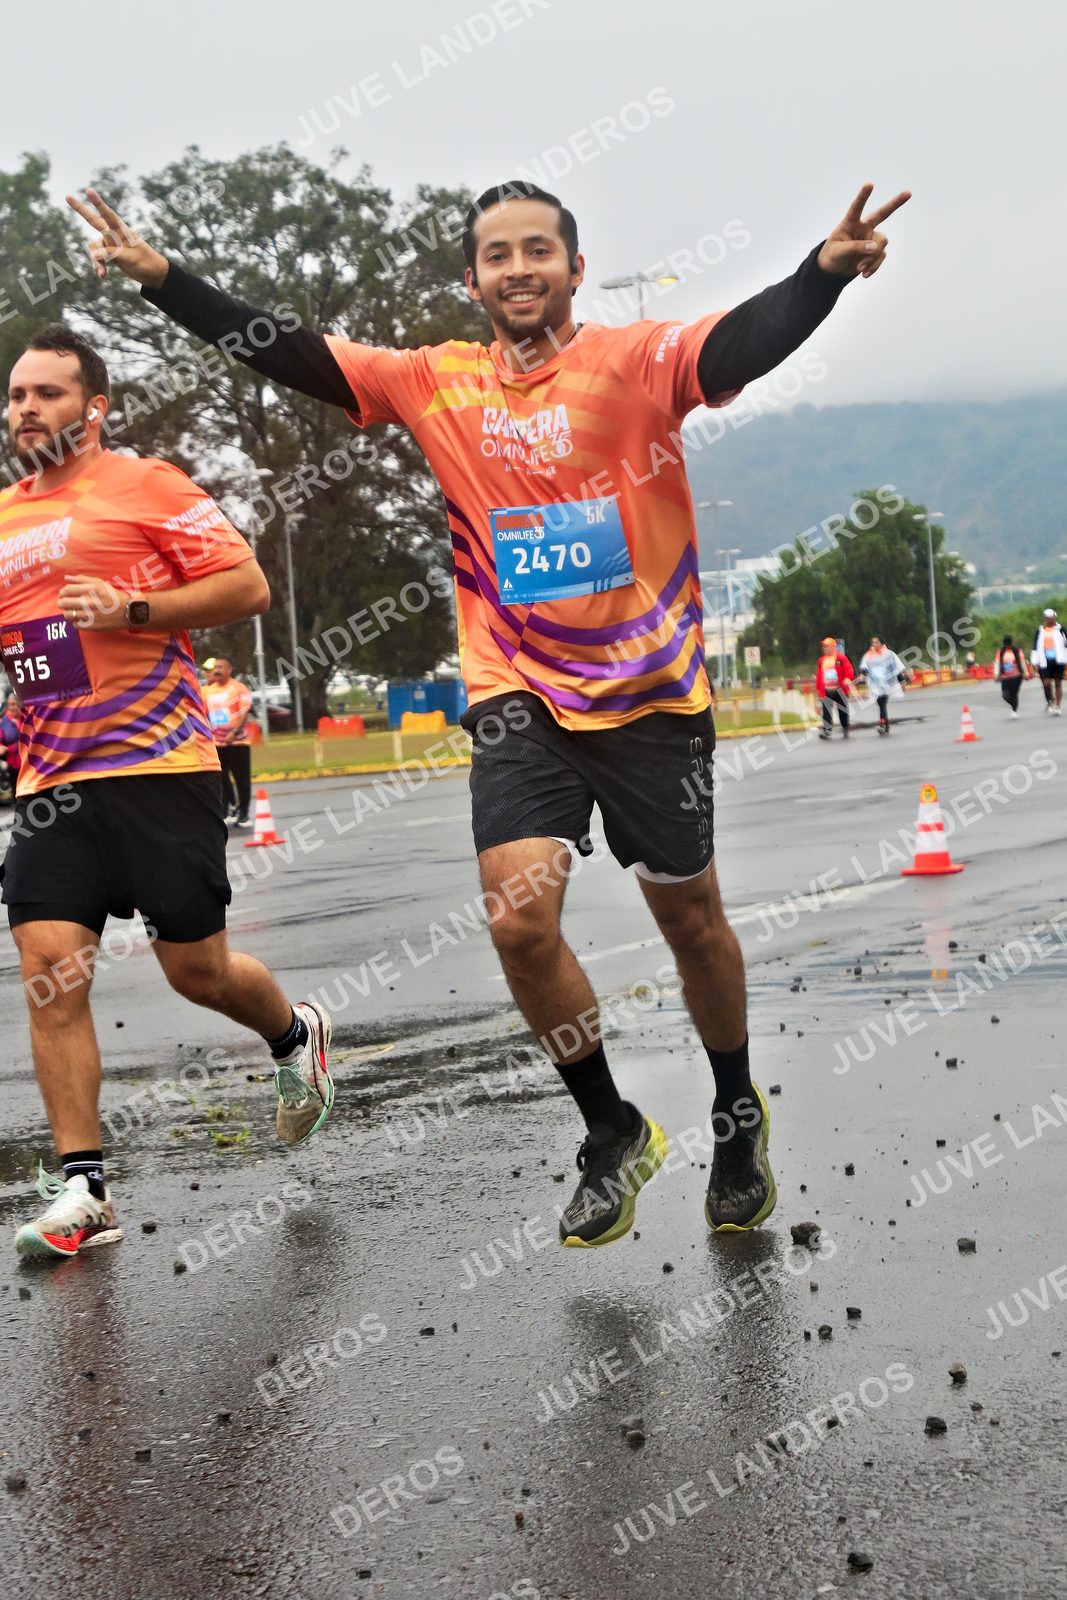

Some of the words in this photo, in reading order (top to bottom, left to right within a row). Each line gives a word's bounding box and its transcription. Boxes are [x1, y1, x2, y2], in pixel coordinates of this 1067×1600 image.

[481, 438, 550, 465] OMNLIFE
[586, 503, 606, 525] 5K
[497, 531, 534, 541] OMNILIFE
[512, 541, 592, 575] 2470
[14, 655, 51, 684] 515
